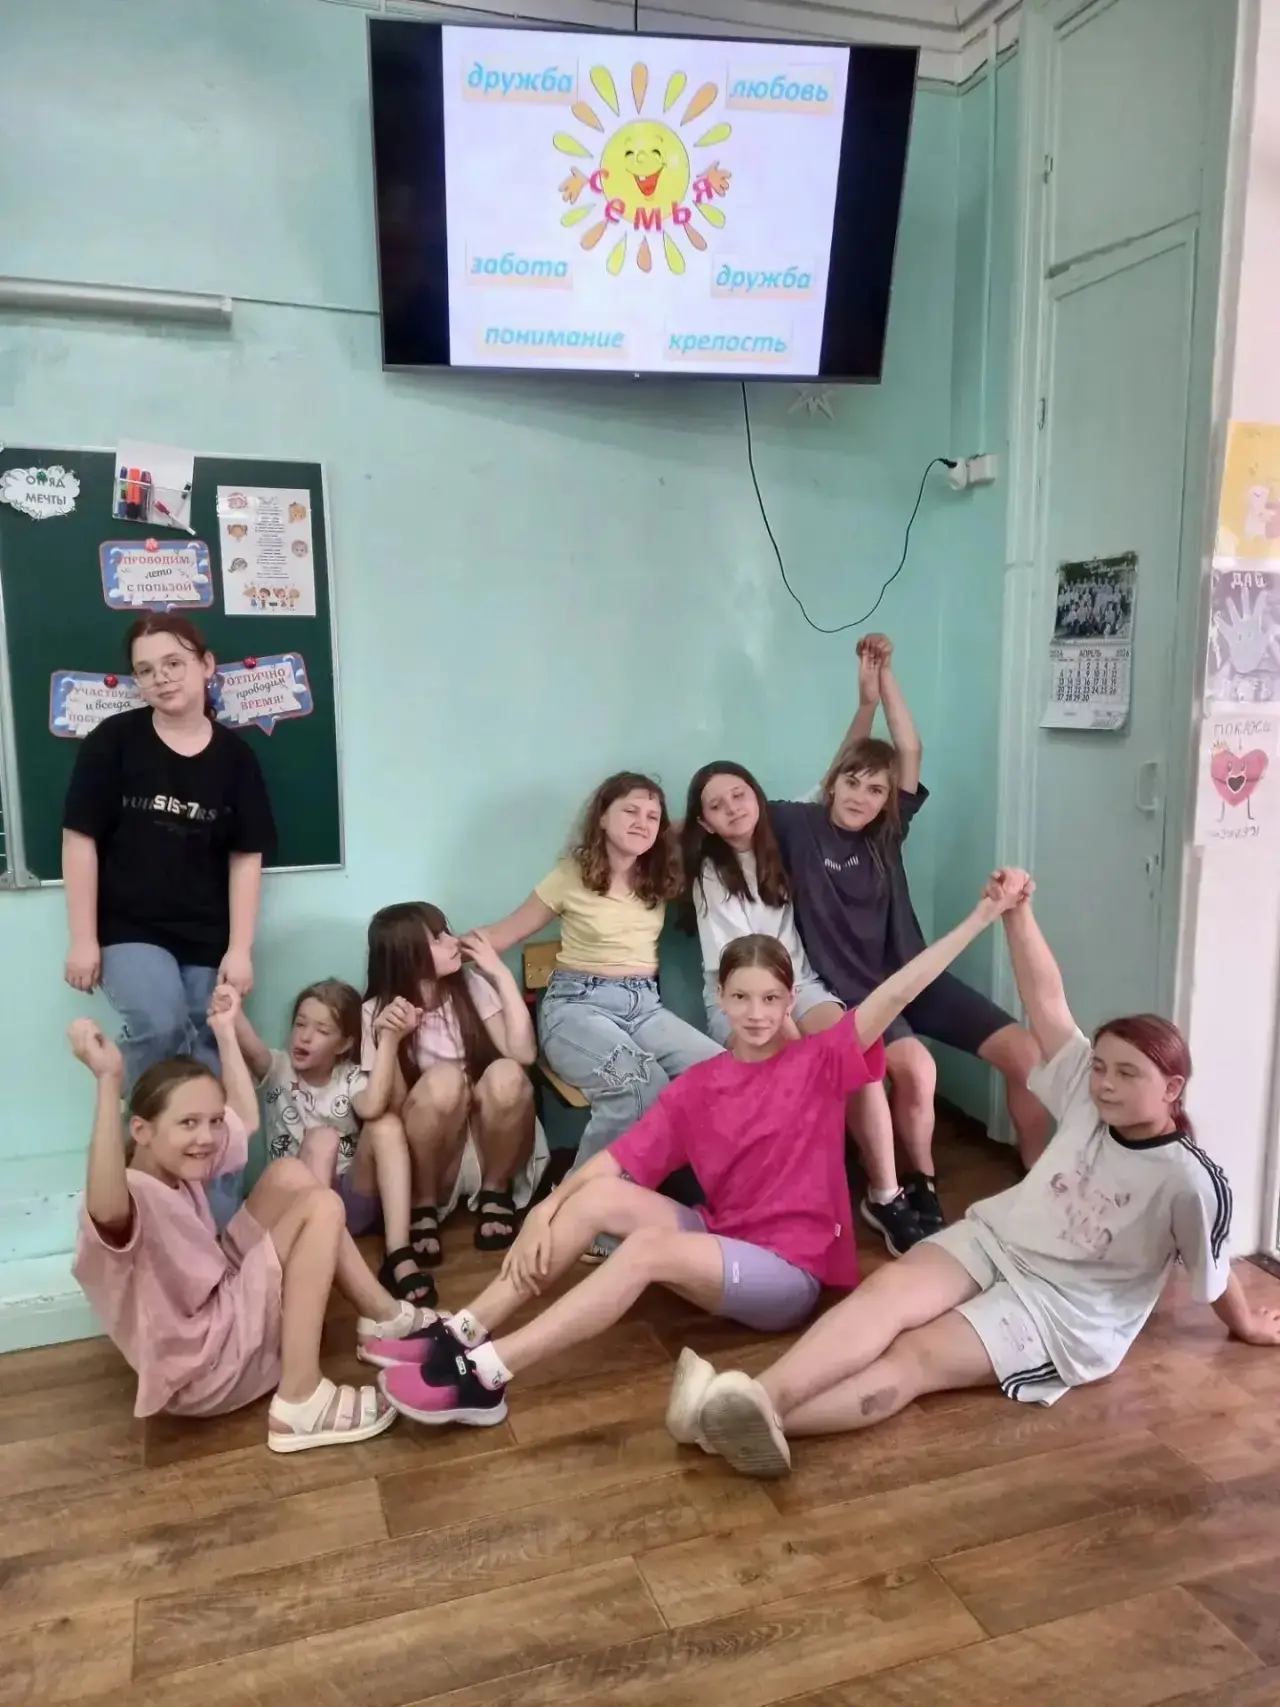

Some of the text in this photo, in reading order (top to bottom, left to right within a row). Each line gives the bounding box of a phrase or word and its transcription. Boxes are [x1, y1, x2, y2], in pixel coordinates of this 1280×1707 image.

[467, 61, 574, 97] дружба
[729, 75, 829, 102] любовь
[470, 252, 569, 278] забота
[716, 263, 812, 293] дружба
[485, 327, 625, 348] понимание
[668, 333, 788, 355] крепость
[25, 493, 67, 505] МЕЧТЫ
[122, 555, 190, 566] ПРОВОДИМ
[137, 582, 192, 593] ПОЛЬЗОЙ
[226, 668, 286, 686] ОТЛИЧНО
[236, 677, 286, 700] проводим
[85, 699, 132, 712] и всегда
[240, 695, 284, 711] ВРЕМЯ!
